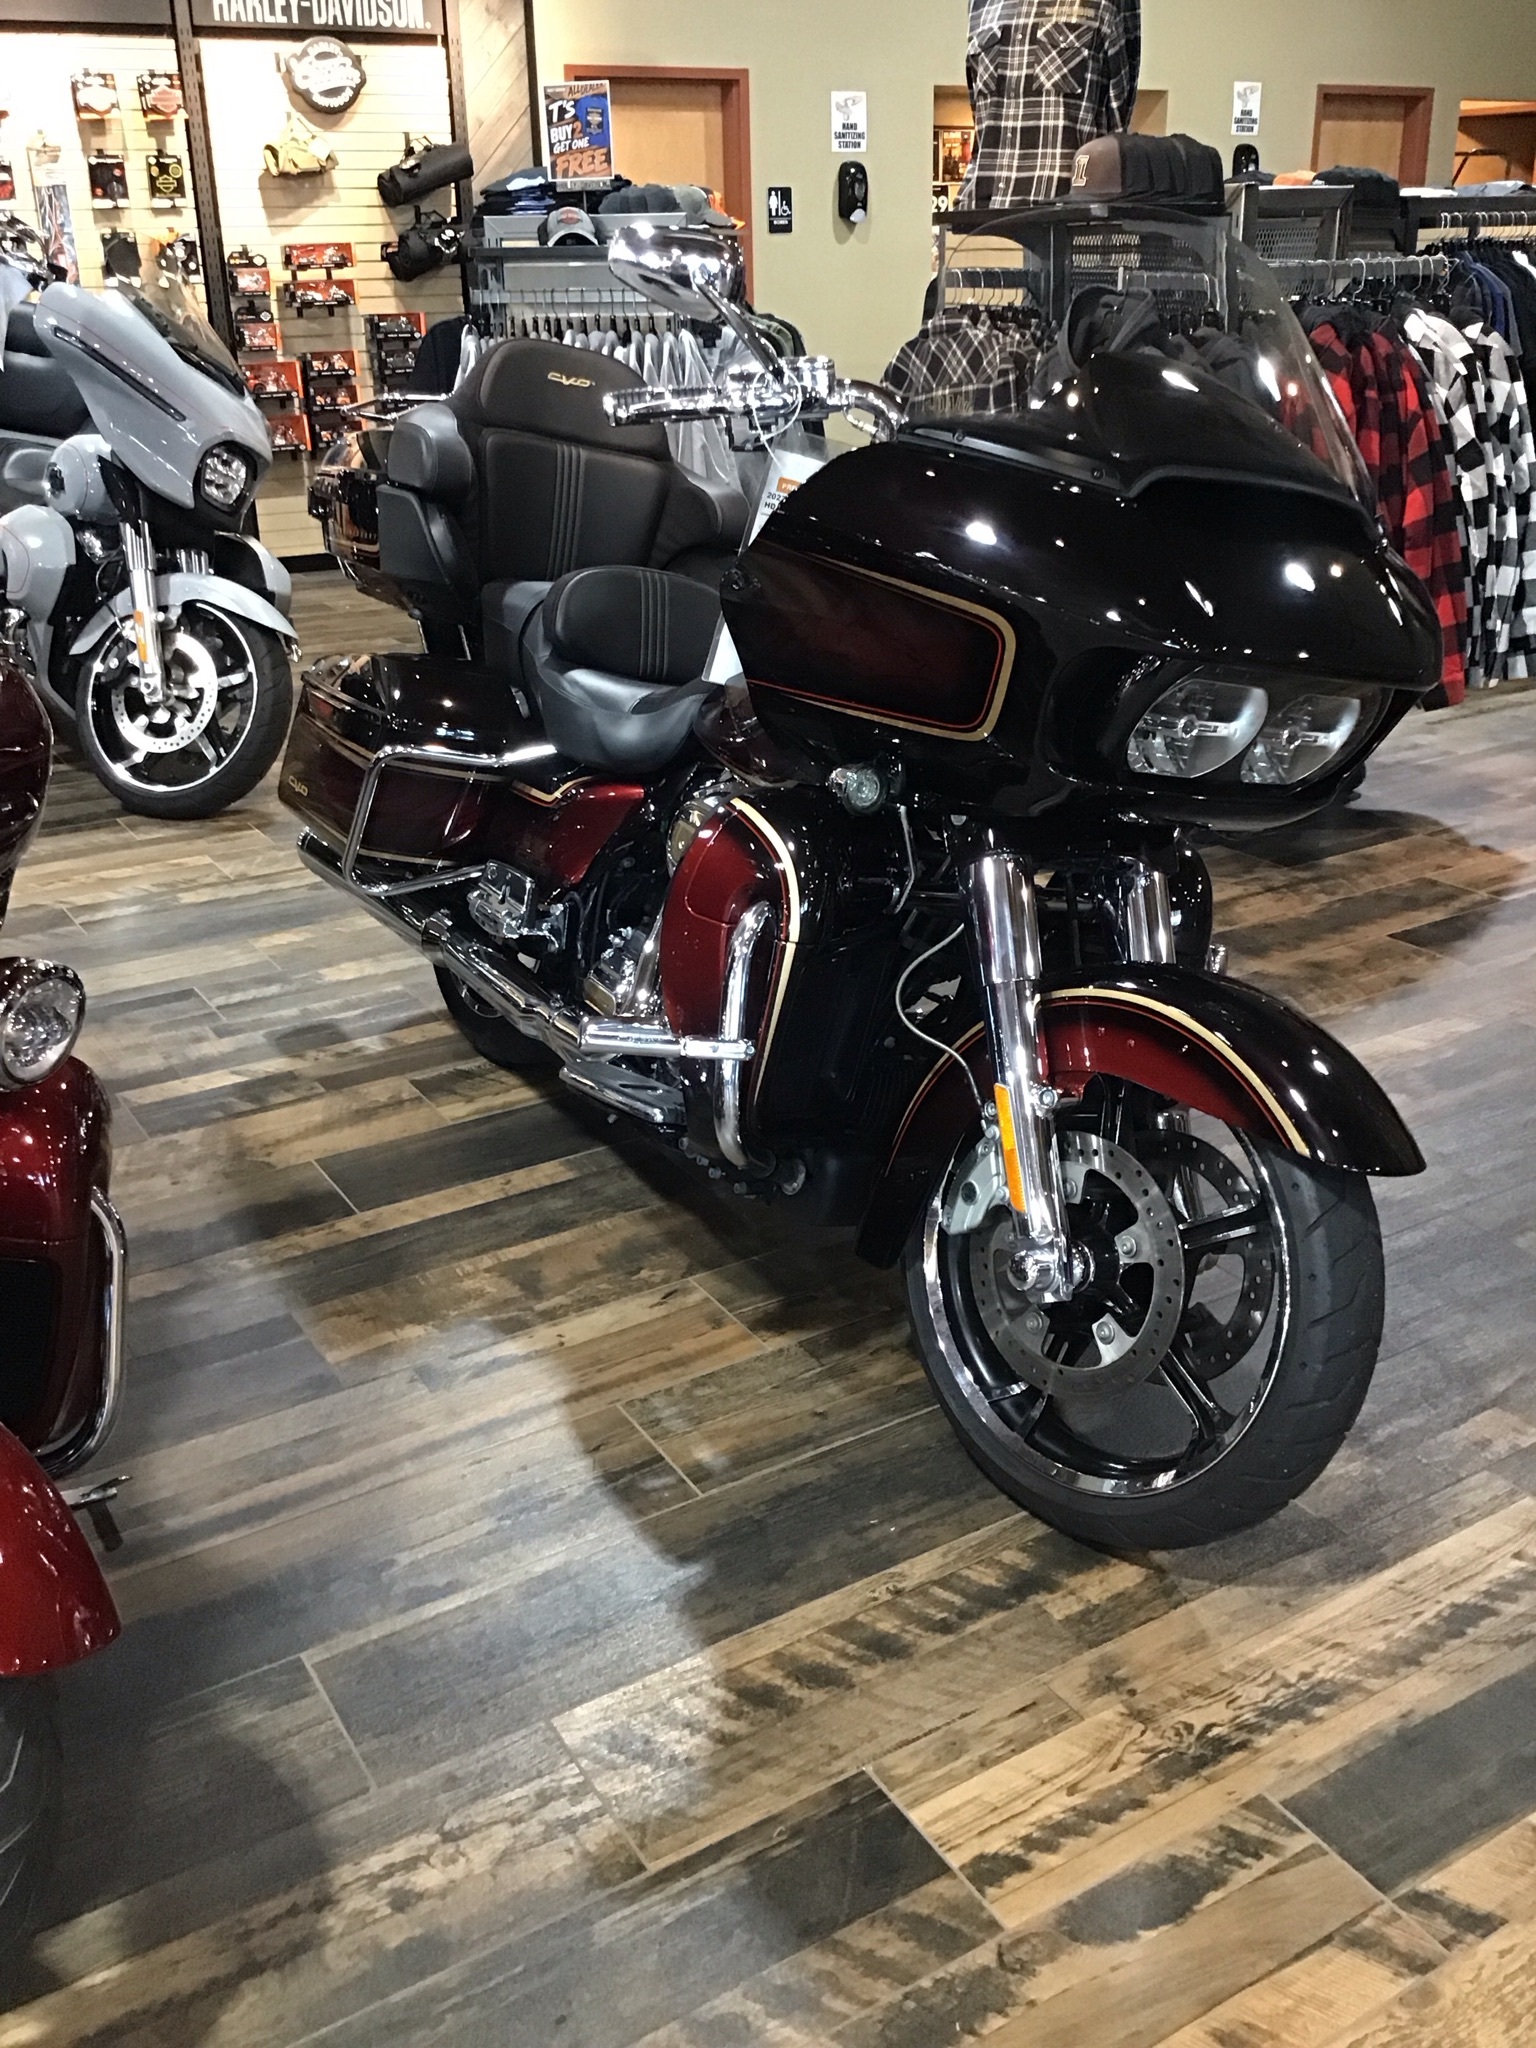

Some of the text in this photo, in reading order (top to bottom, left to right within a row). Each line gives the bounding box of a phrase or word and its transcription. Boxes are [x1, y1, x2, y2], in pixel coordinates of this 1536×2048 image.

[549, 100, 576, 122] T'S
[550, 124, 573, 143] BUY
[573, 120, 583, 139] 2
[842, 122, 858, 131] HAND
[834, 131, 866, 140] SANITIZING
[553, 137, 590, 154] GET ONE
[838, 140, 862, 149] STATION
[556, 148, 609, 179] FREE
[548, 372, 591, 388] CVO
